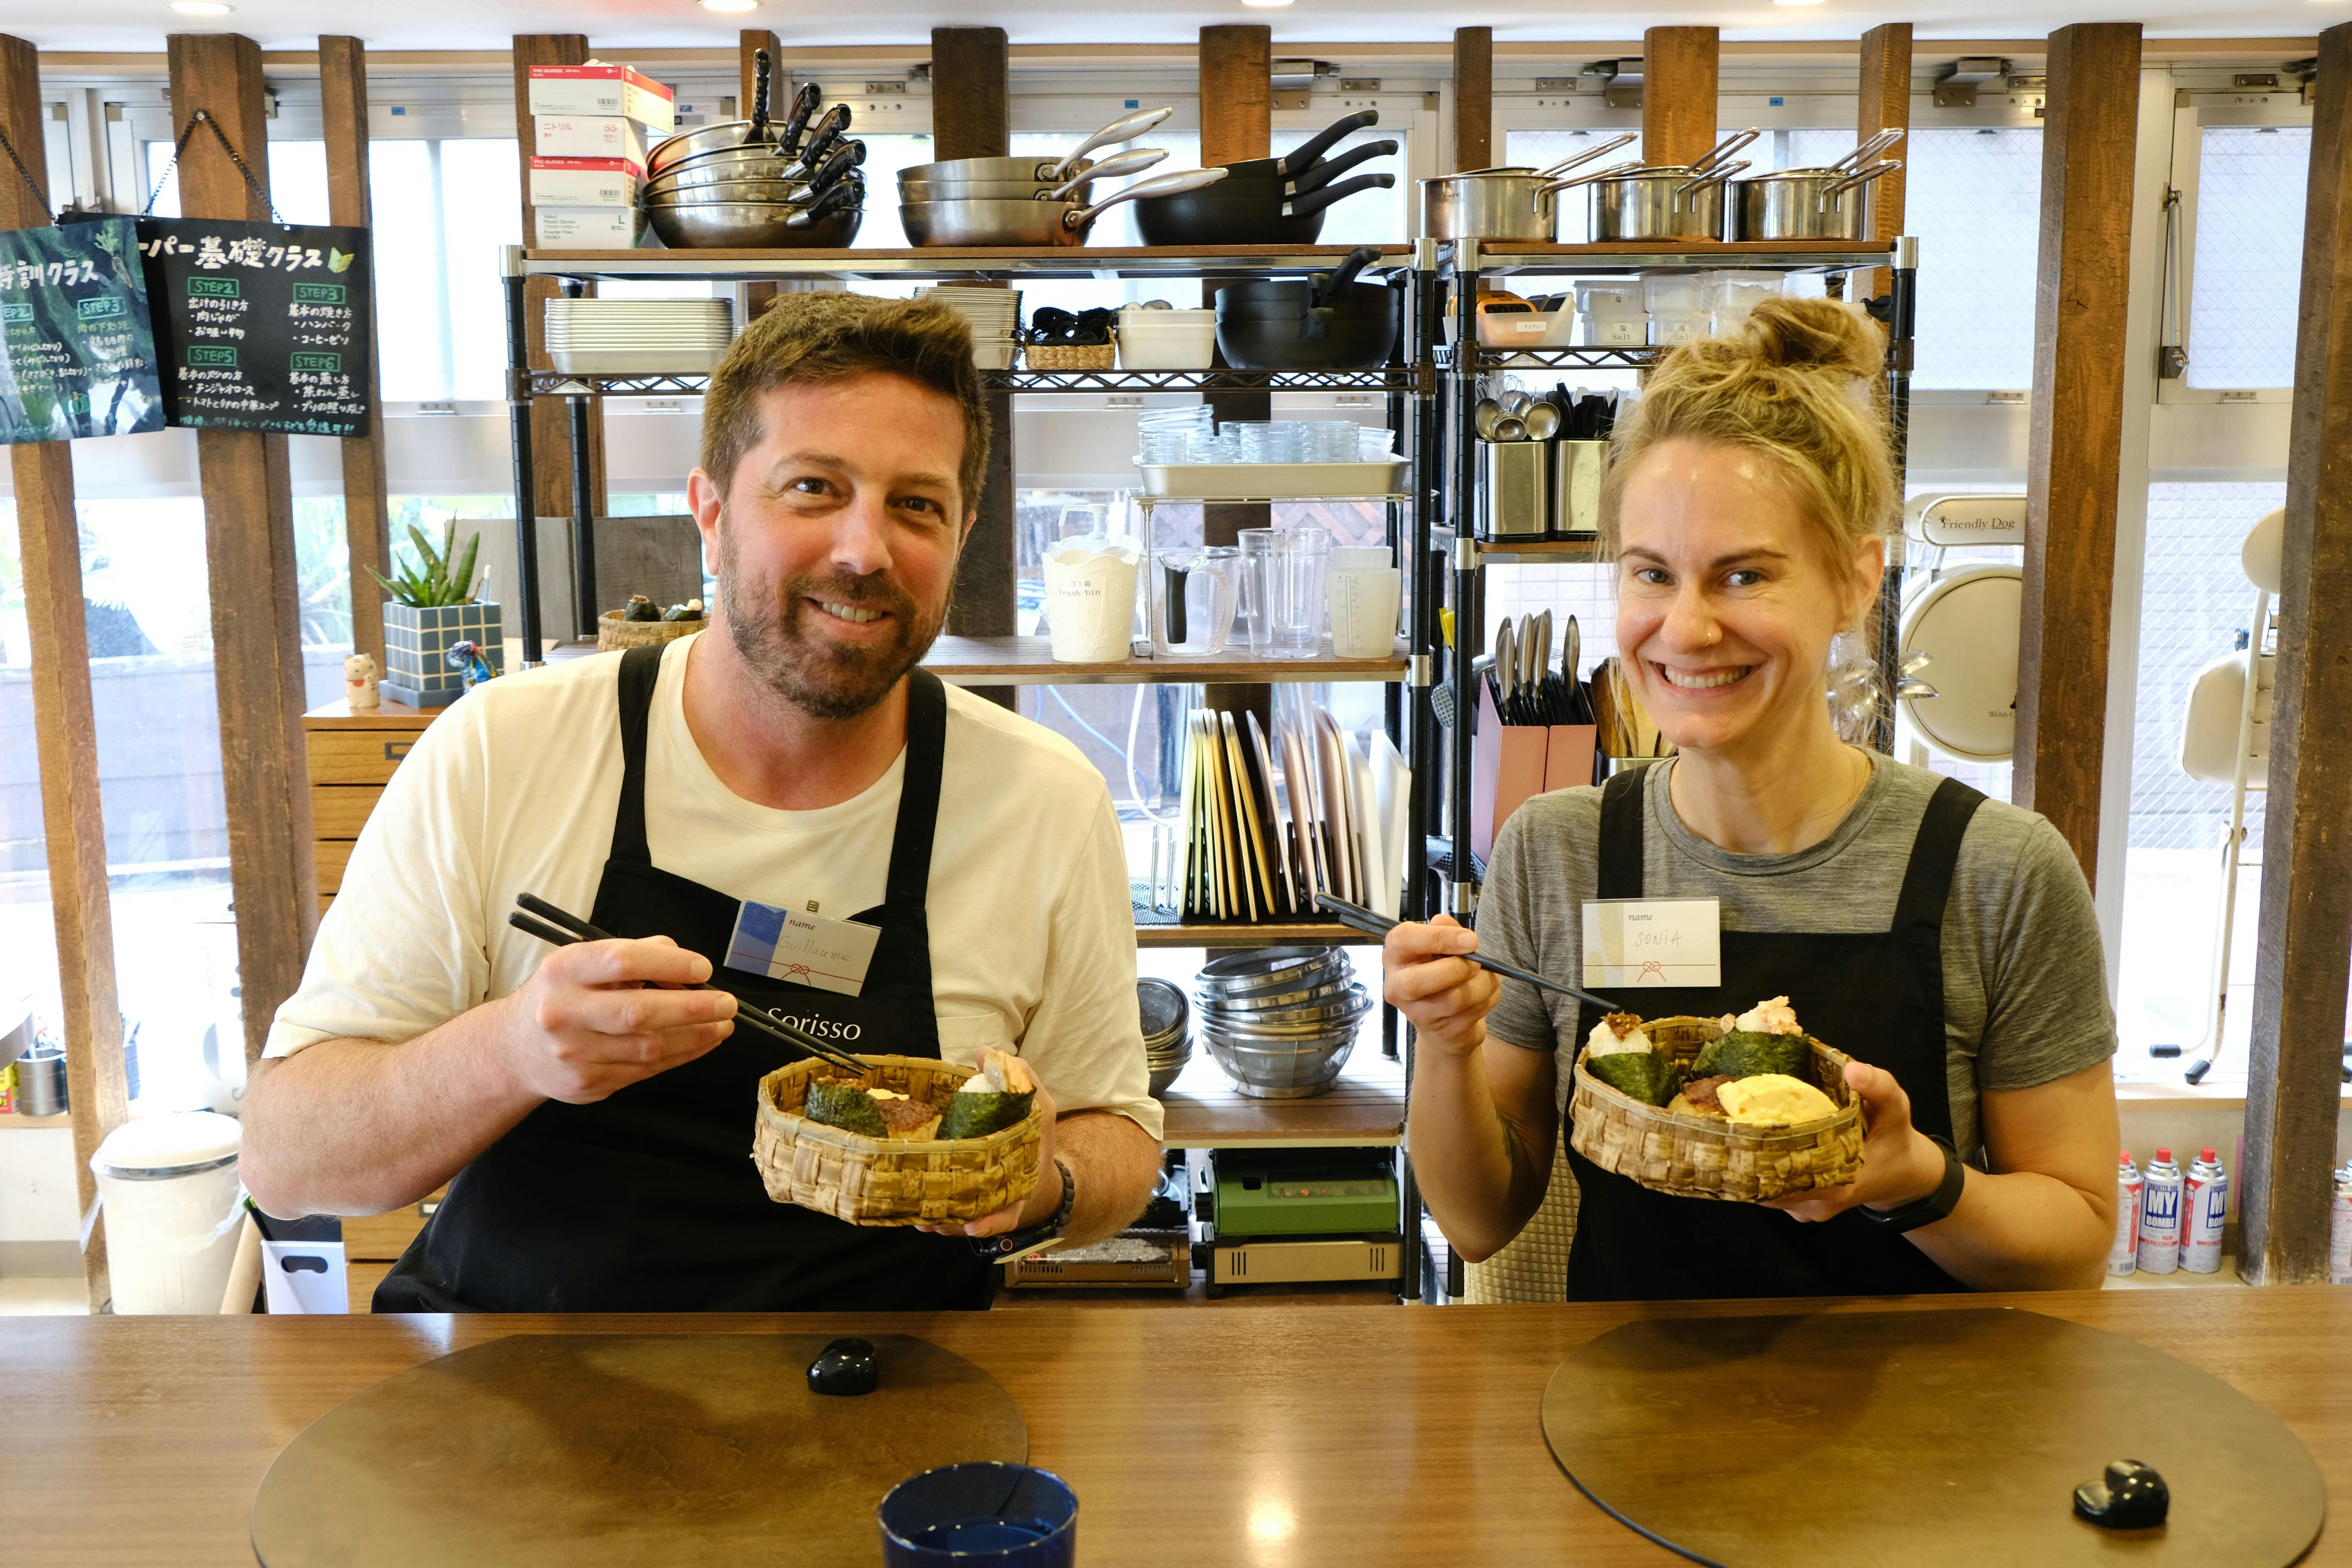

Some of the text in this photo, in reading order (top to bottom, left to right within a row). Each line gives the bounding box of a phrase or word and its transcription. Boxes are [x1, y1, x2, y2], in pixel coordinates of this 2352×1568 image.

[619, 215, 625, 224] L
[194, 280, 235, 294] STEP2
[300, 287, 338, 301] STEP3
[83, 300, 120, 315] STEP3
[194, 349, 233, 363] STEP5
[296, 356, 335, 369] STEP6
[1942, 518, 2015, 531] Friendly Dog
[789, 919, 815, 931] name
[778, 936, 851, 962] Guillaume
[2148, 1189, 2177, 1215] MY
[2146, 1215, 2175, 1228] BOMBE
